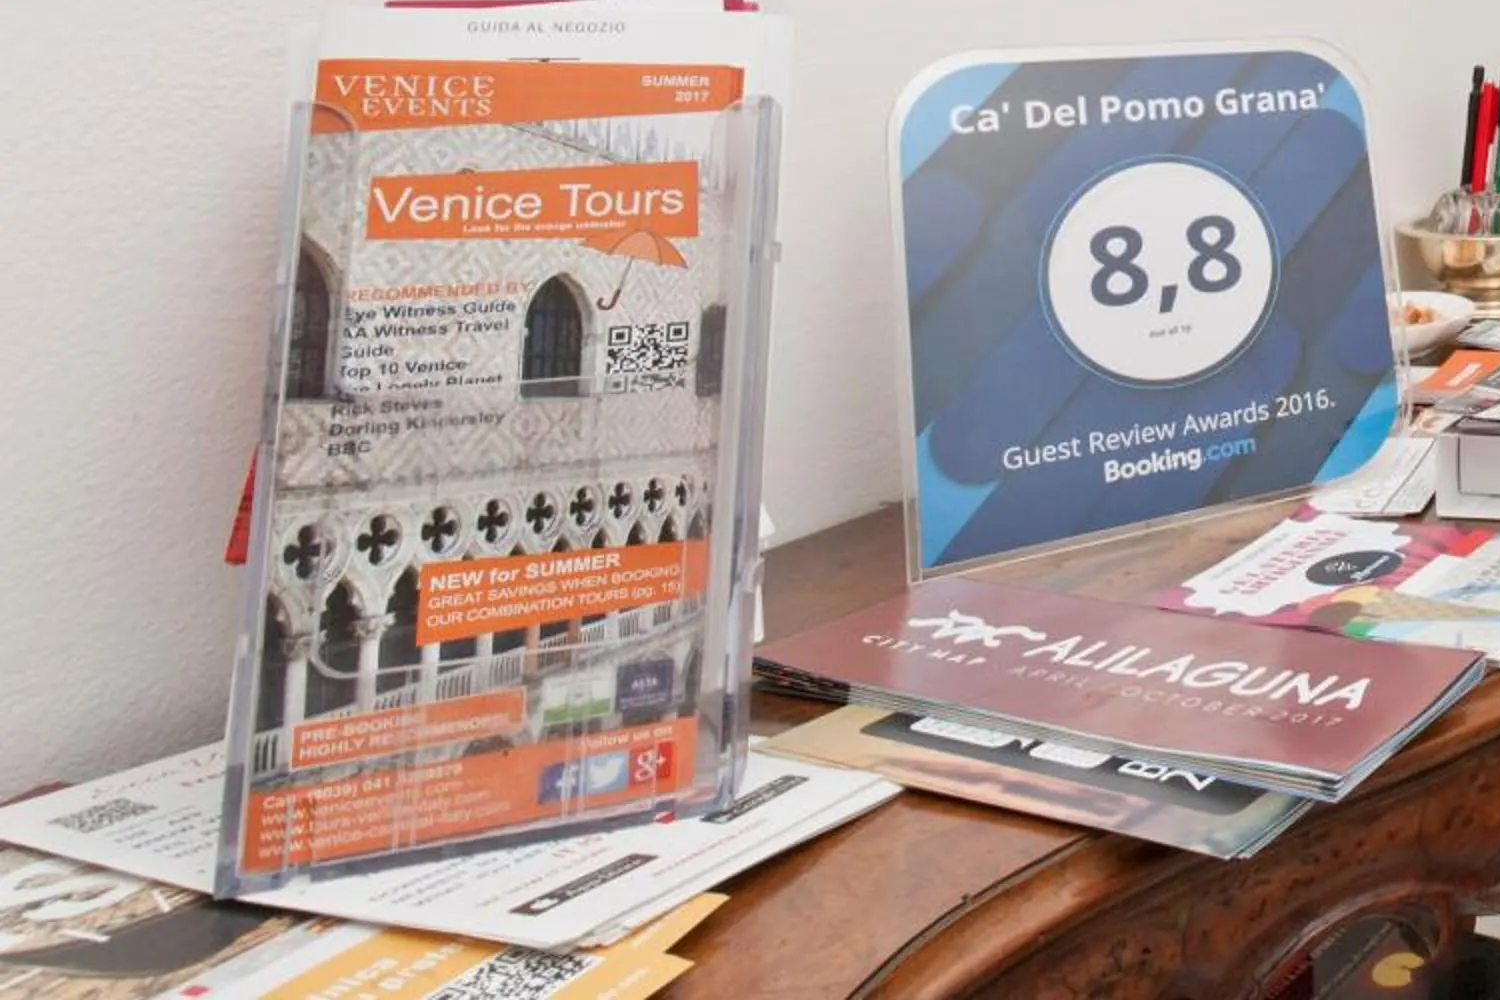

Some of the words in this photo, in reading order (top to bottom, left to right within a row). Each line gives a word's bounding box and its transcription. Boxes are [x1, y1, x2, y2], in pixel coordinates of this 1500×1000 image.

[467, 21, 521, 34] GUIDA
[526, 22, 544, 34] AL
[552, 21, 625, 34] NEGOZIO
[334, 74, 496, 98] VENICE
[641, 74, 710, 88] SUMMER
[675, 90, 710, 103] 2017
[362, 98, 492, 117] EVENTS
[948, 101, 1011, 135] Ca'
[1023, 95, 1088, 129] Del
[1099, 91, 1204, 124] Pomo
[1213, 82, 1326, 116] Grana'
[373, 186, 542, 224] Venice
[559, 183, 685, 217] Tours
[1088, 213, 1244, 314] 8,8
[382, 302, 457, 319] Witness
[463, 300, 517, 315] Guide
[374, 323, 449, 338] Witness
[457, 318, 510, 333] Travel
[339, 364, 372, 380] Top
[379, 361, 400, 376] 10
[406, 359, 468, 374] Venice
[380, 398, 444, 414] Steves
[1002, 438, 1082, 471] Guest
[1088, 418, 1177, 453] Review
[1183, 401, 1270, 435] Awards
[1276, 388, 1337, 416] 2016.
[1103, 433, 1257, 484] Booking.com
[427, 590, 485, 610] GREAT
[487, 580, 558, 602] SAVINGS
[561, 572, 609, 591] WHEN
[611, 564, 679, 585] BOOKING
[429, 569, 484, 593] NEW
[488, 566, 520, 584] for
[524, 551, 621, 579] SUMMER
[426, 610, 465, 629] OUR
[465, 596, 576, 623] COMBINATION
[577, 587, 630, 607] TOURS
[862, 633, 929, 660] CITY
[931, 646, 987, 666] MAP
[1023, 635, 1372, 709] ALILAGUNA
[1010, 665, 1085, 689] APRIL
[1120, 684, 1264, 718] OCTOBER
[1270, 709, 1343, 728] 2017
[299, 736, 366, 761] HIGHLY
